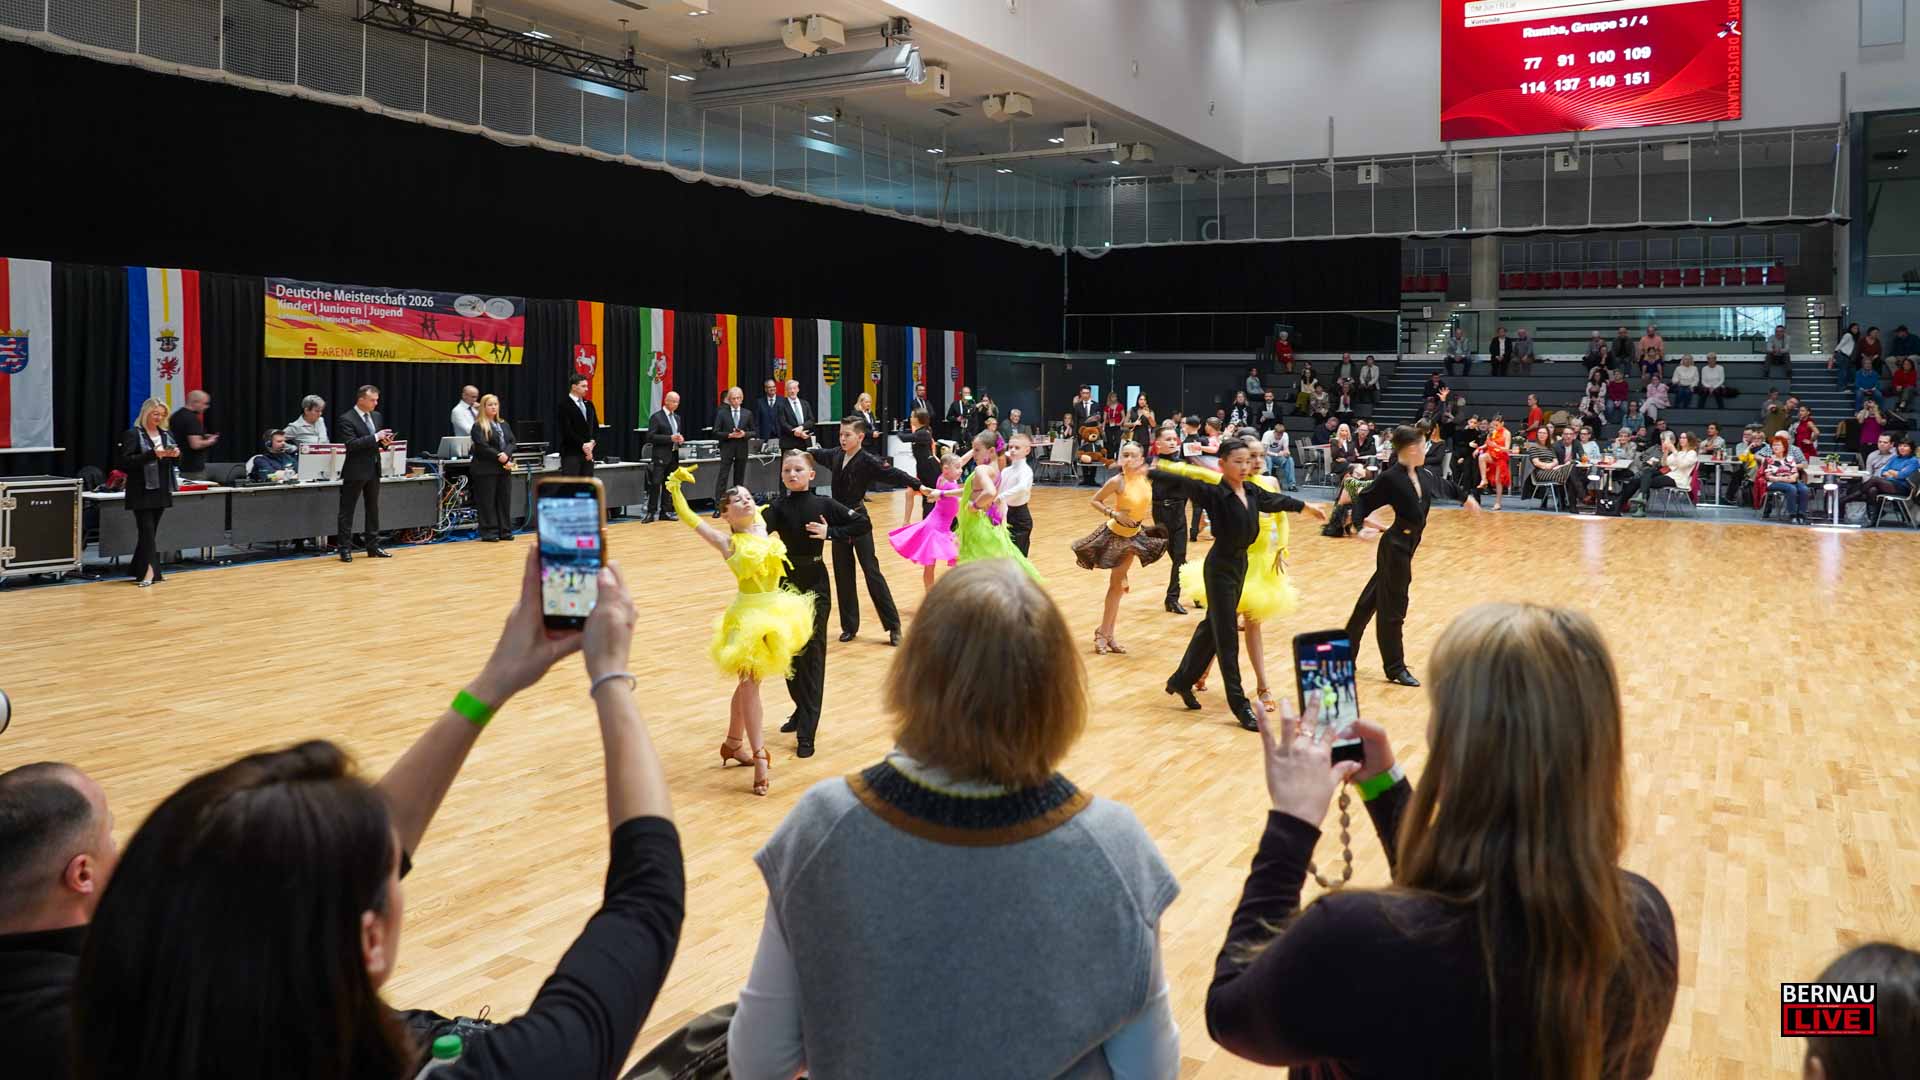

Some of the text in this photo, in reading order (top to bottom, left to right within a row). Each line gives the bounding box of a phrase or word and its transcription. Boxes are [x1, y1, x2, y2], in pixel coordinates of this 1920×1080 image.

[1571, 20, 1617, 32] Gruppe
[1619, 17, 1628, 28] 3
[1639, 15, 1648, 26] 4
[1523, 46, 1652, 70] 77 91 100 109
[1520, 71, 1650, 94] 114 137 140 151
[1727, 37, 1740, 117] DEUTSCHLAND
[275, 284, 434, 307] Deutsche Meisterschaft 2026
[278, 299, 312, 311] Kinder
[319, 302, 362, 315] Junioren
[369, 305, 403, 319] Jugend
[356, 347, 397, 359] BERNAU
